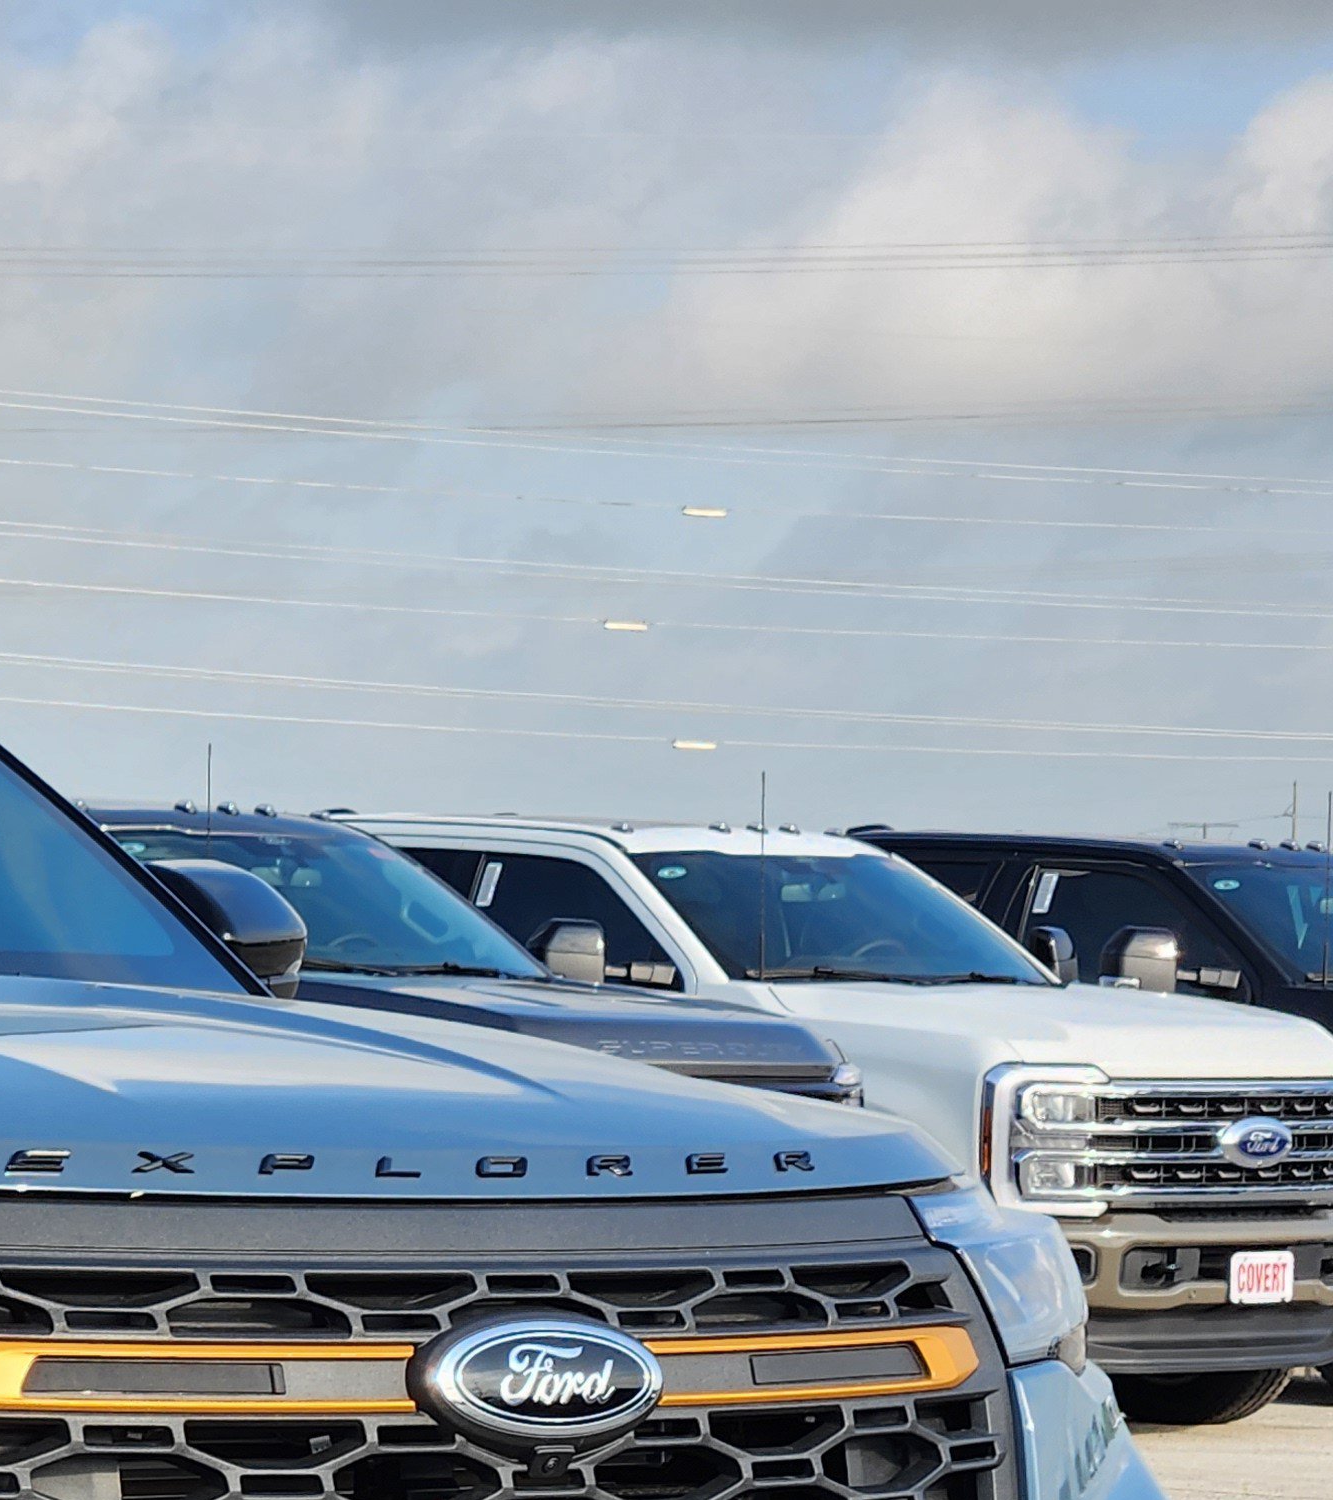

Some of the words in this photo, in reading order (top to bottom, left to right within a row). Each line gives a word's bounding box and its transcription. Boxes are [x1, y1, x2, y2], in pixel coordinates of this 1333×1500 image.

[1246, 1131, 1280, 1153] Ford
[4, 1149, 814, 1178] EXPLORER
[1237, 1263, 1287, 1292] COVERT
[500, 1343, 615, 1406] Ford
